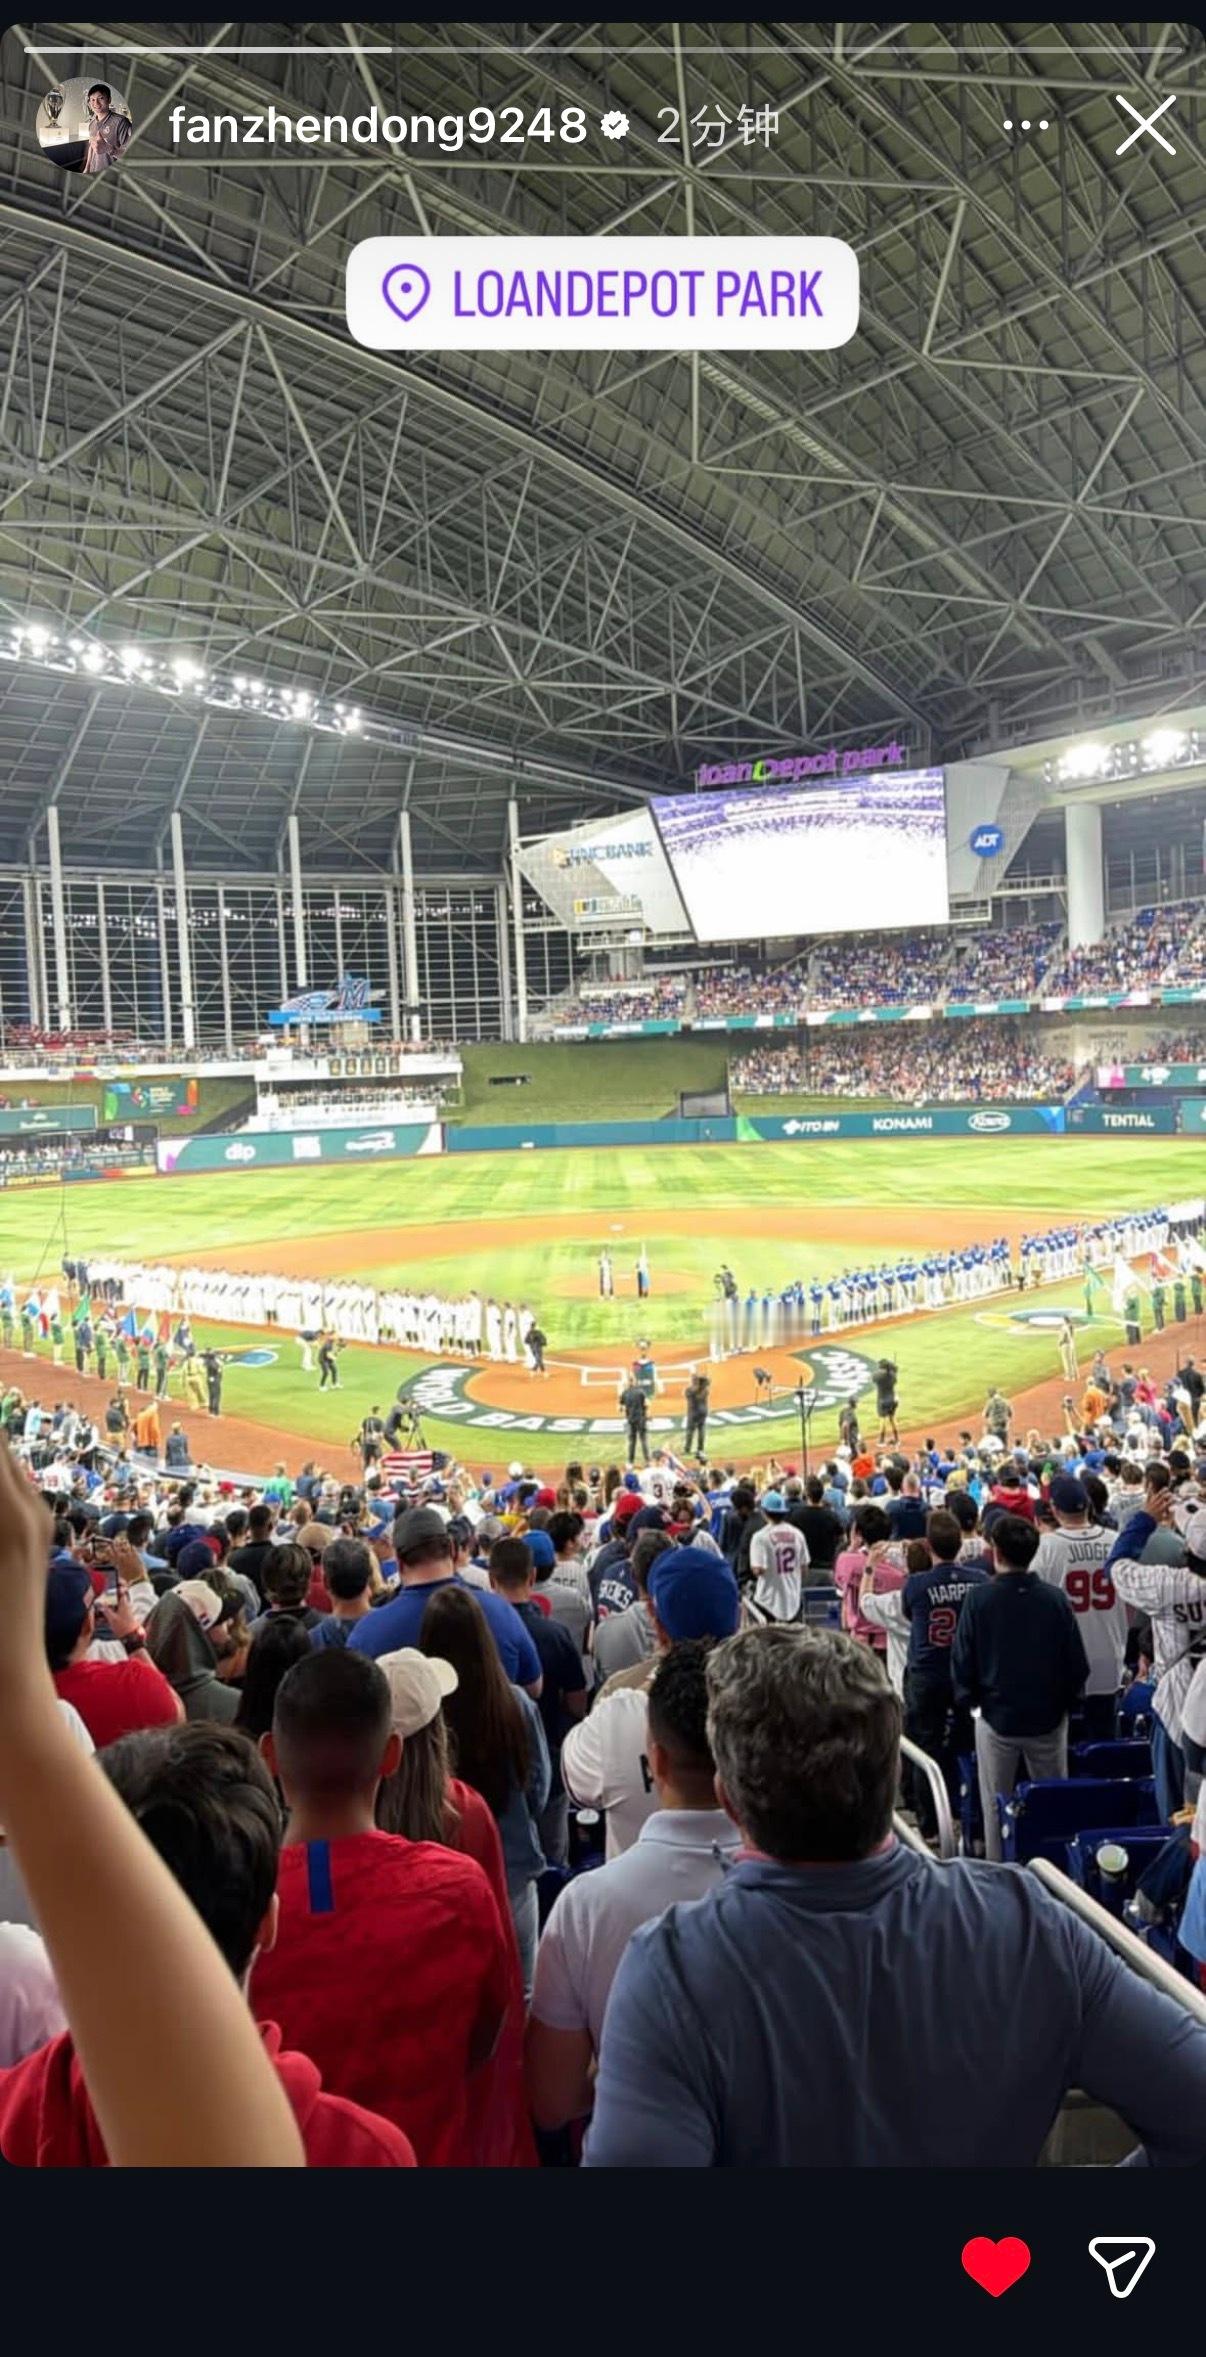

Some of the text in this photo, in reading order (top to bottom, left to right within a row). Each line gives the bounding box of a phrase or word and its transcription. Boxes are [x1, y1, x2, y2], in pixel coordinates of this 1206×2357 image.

[843, 741, 904, 772] park
[975, 833, 1000, 848] ADT
[872, 1116, 933, 1131] KONAMI
[1103, 1114, 1155, 1127] TENTIAL
[775, 1547, 795, 1574] 12
[1066, 1568, 1116, 1614] 99
[1173, 1602, 1206, 1623] SU
[928, 1607, 956, 1646] 2
